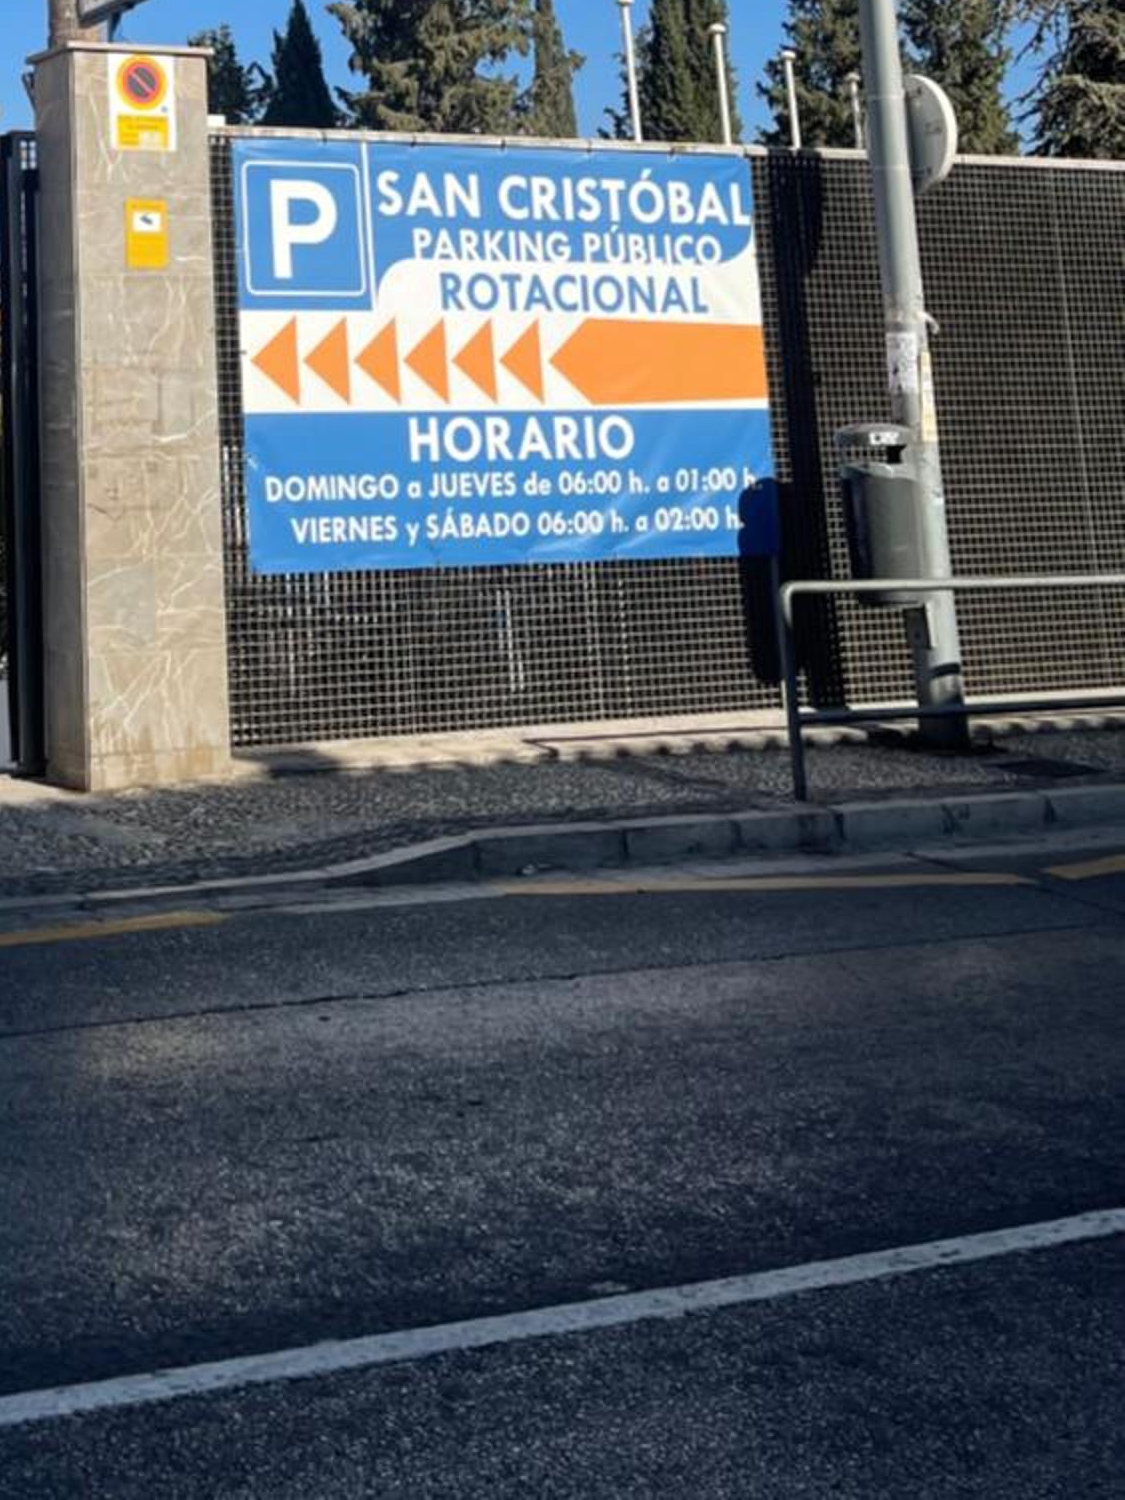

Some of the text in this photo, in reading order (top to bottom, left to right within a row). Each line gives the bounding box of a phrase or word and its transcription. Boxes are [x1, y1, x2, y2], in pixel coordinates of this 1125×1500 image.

[377, 168, 751, 226] SAN CRISTÓBAL
[270, 179, 338, 279] P
[412, 225, 722, 264] PARKING PÚBLICO
[439, 272, 709, 314] ROTACIONAL
[408, 414, 635, 463] HORARIO
[265, 474, 400, 503] DOMINGO
[407, 480, 422, 498] a
[428, 471, 516, 498] JUEVES
[523, 471, 552, 496] de
[558, 469, 622, 495] 06:00
[628, 469, 651, 494] h.
[656, 475, 670, 492] a
[676, 467, 737, 492] 01:00
[291, 515, 398, 544] VIERNES
[406, 521, 420, 547] y
[426, 506, 531, 540] SÁBADO
[537, 511, 604, 536] 06:00
[611, 509, 630, 533] h.
[635, 515, 648, 532] a
[654, 506, 720, 531] 02:00
